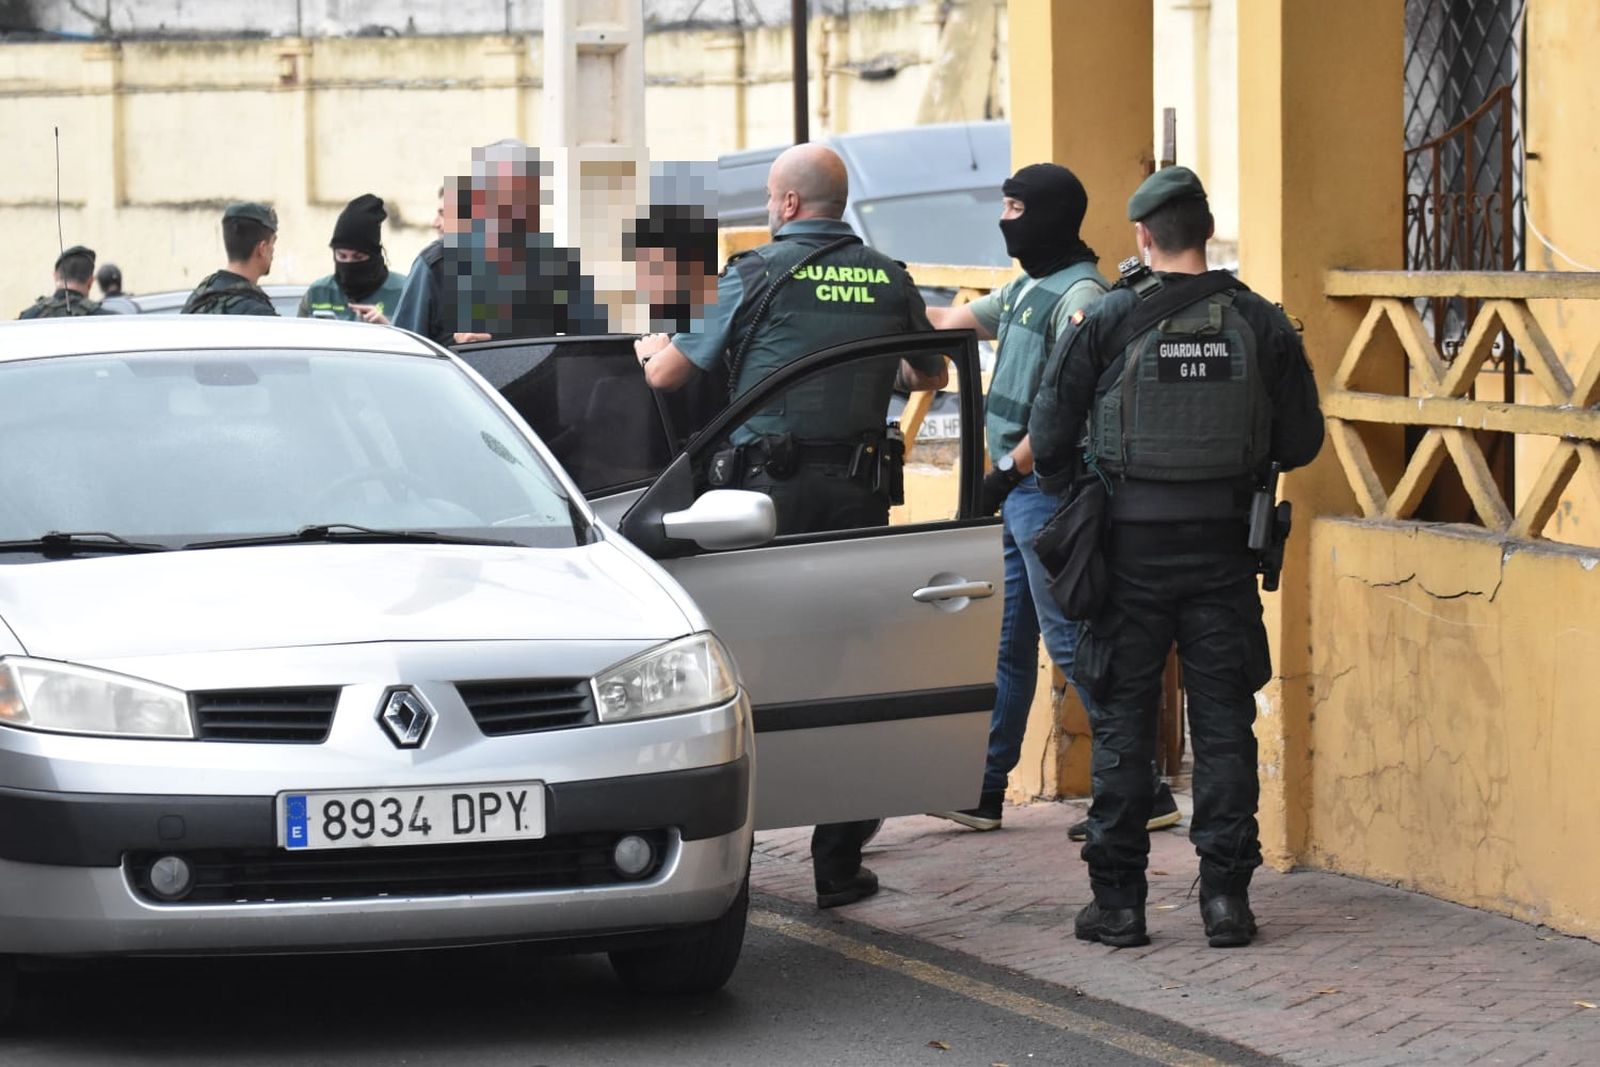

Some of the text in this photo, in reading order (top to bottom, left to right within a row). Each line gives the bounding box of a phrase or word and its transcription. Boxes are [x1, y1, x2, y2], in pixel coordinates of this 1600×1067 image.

[793, 265, 890, 284] GUARDIA
[815, 284, 875, 303] CIVIL
[1159, 342, 1229, 358] GUARDIA CIVIL
[322, 790, 528, 841] 8934 DPY
[292, 826, 302, 838] E
